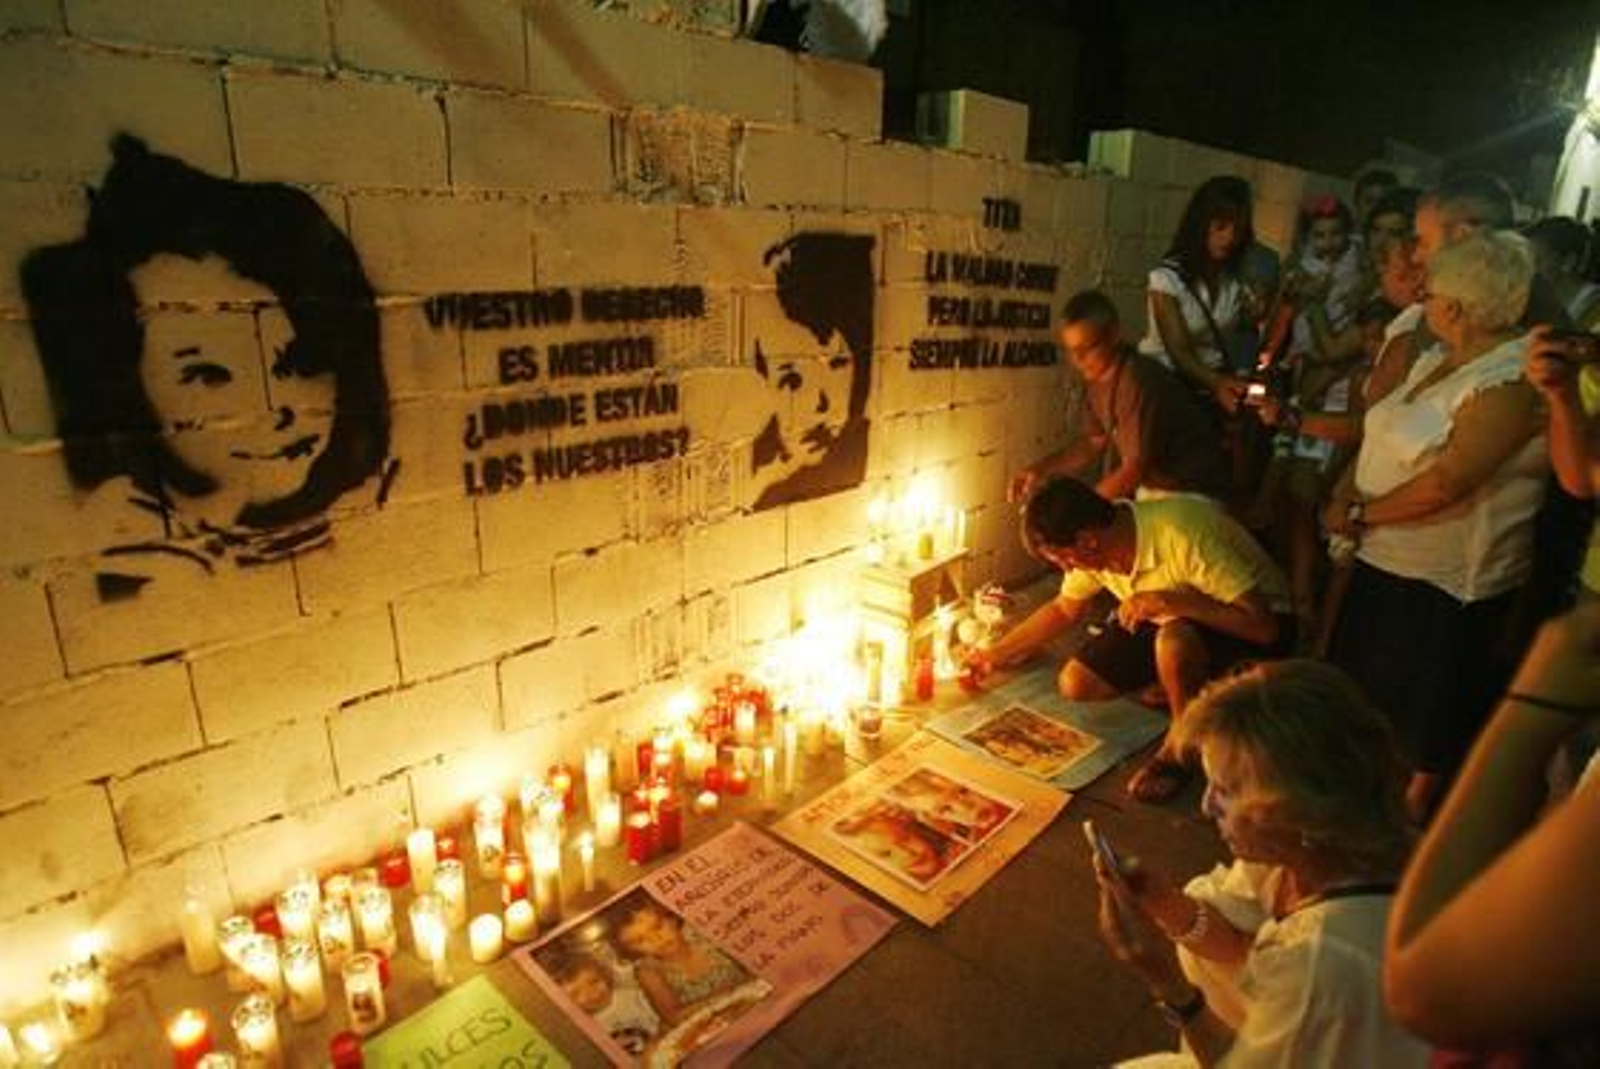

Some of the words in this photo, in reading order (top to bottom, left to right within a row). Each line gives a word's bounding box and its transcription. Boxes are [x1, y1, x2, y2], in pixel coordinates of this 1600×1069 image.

[500, 346, 538, 384] ES
[464, 454, 525, 496] LOS
[534, 427, 690, 484] NUESTROS?
[655, 870, 686, 895] EN
